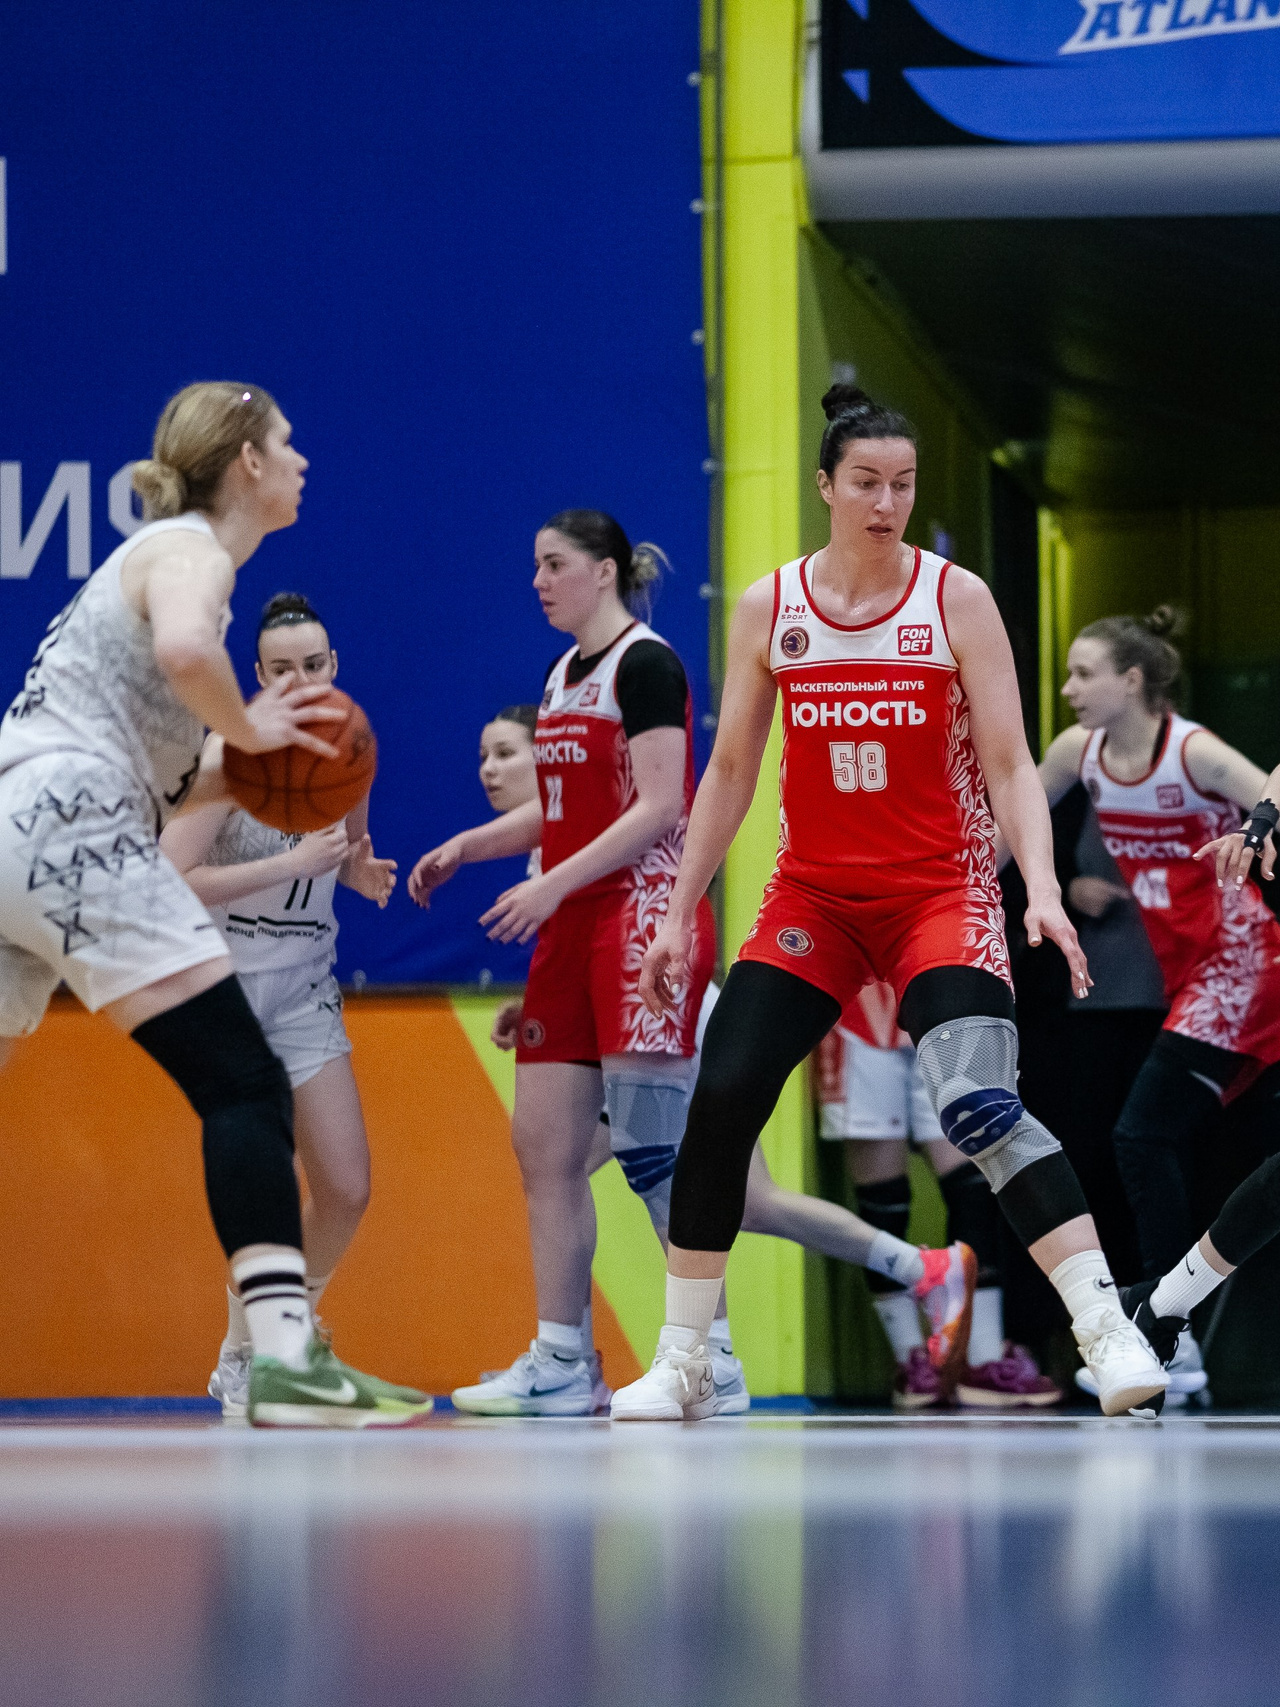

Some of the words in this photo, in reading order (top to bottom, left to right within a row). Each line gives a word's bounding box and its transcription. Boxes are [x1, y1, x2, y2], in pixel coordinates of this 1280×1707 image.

[900, 627, 930, 640] FON
[900, 639, 931, 652] BET
[789, 680, 888, 693] БАСКЕТБОЛЬНЫЙ
[892, 680, 926, 691] КЛУБ
[791, 701, 928, 728] ЮНОСТЬ
[828, 741, 888, 794] 58
[225, 925, 255, 939] ФОНД
